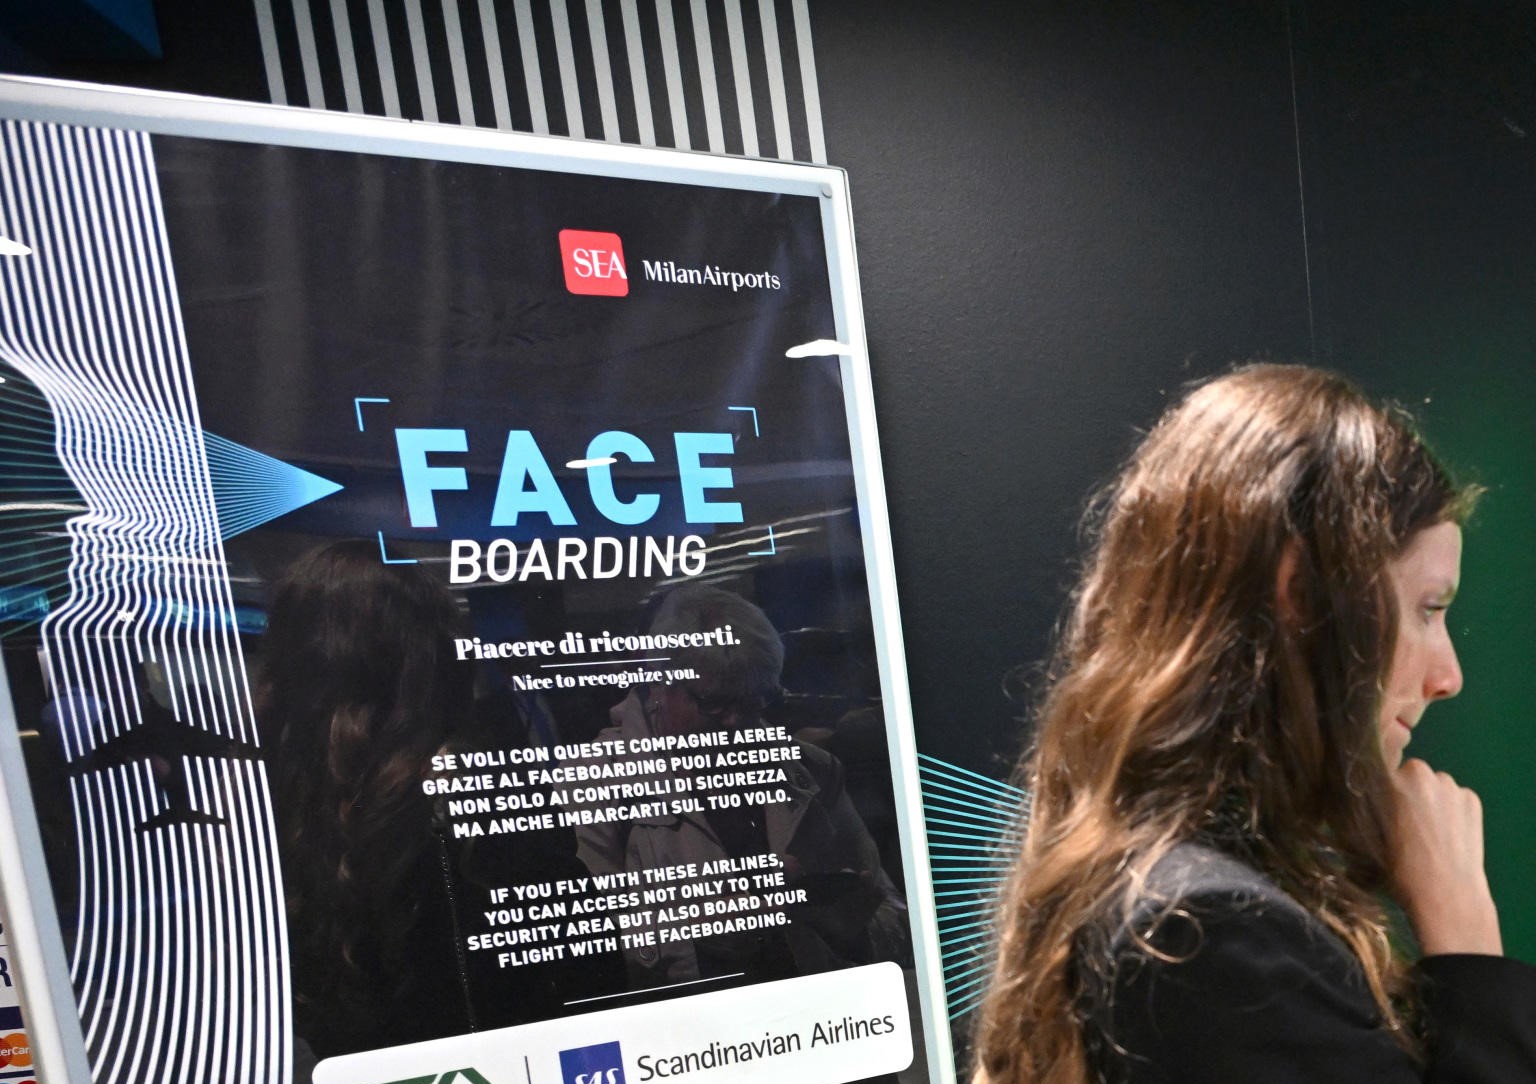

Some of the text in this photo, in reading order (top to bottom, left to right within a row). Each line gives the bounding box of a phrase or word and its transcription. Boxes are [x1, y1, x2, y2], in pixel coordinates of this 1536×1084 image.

[574, 248, 626, 280] SEA
[642, 260, 781, 292] MilanAirports
[395, 429, 744, 528] FACE
[450, 536, 707, 584] BOARDING
[454, 625, 741, 660] Piacere di riconoscerti.
[512, 667, 700, 691] Nice to recognize you.
[422, 746, 801, 795] GRAZIE AL FACEBOARDING PUOI ACCEDERE
[431, 726, 792, 771] SE VOLI CON QUESTE COMPAGNIE AEREE,
[448, 768, 787, 816] NON SOLO AI CONTROLLI DI SICUREZZA
[453, 789, 791, 838] MA ANCHE IMBARCARTI SUL TUO VOLO.
[484, 872, 785, 926] YOU CAN ACCESS NOT ONLY TO THE
[490, 853, 784, 904] IF YOU FLY WITH THESE AIRLINES,
[467, 889, 808, 950] SECURITY AREA BUT ALSO BOARD YOUR
[498, 912, 791, 968] FLIGHT WITH THE FACEBOARDING.
[637, 1015, 894, 1081] Scandinavian Airlines
